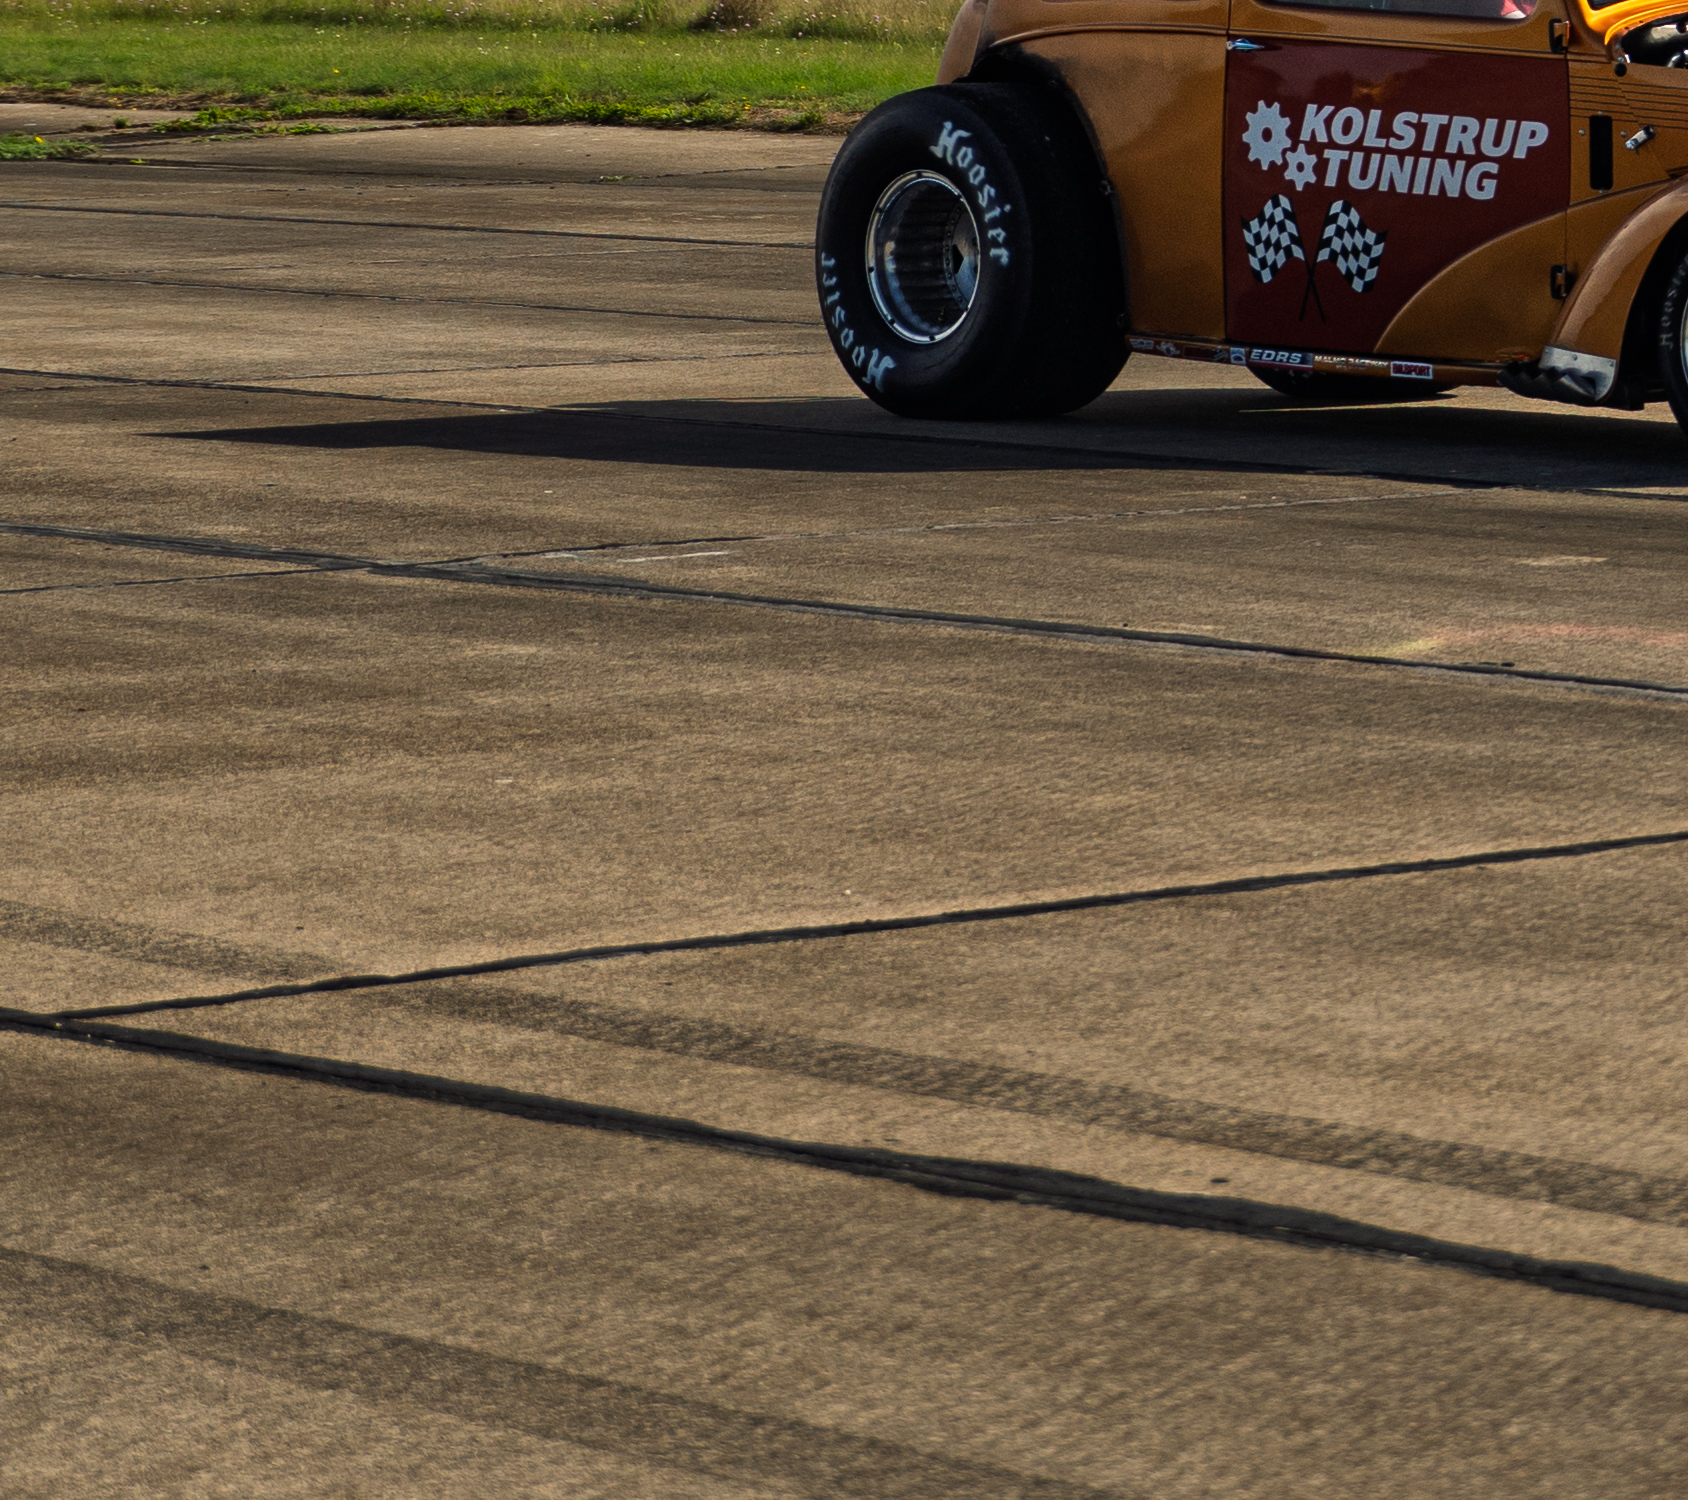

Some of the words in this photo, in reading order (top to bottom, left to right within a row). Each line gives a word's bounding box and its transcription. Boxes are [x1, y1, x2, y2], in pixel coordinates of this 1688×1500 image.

[1300, 103, 1549, 159] KOLSTRUP
[928, 120, 1011, 267] Hoosier
[1323, 149, 1499, 200] TUNING
[821, 252, 896, 392] Hoosier
[1250, 348, 1303, 364] EDRS
